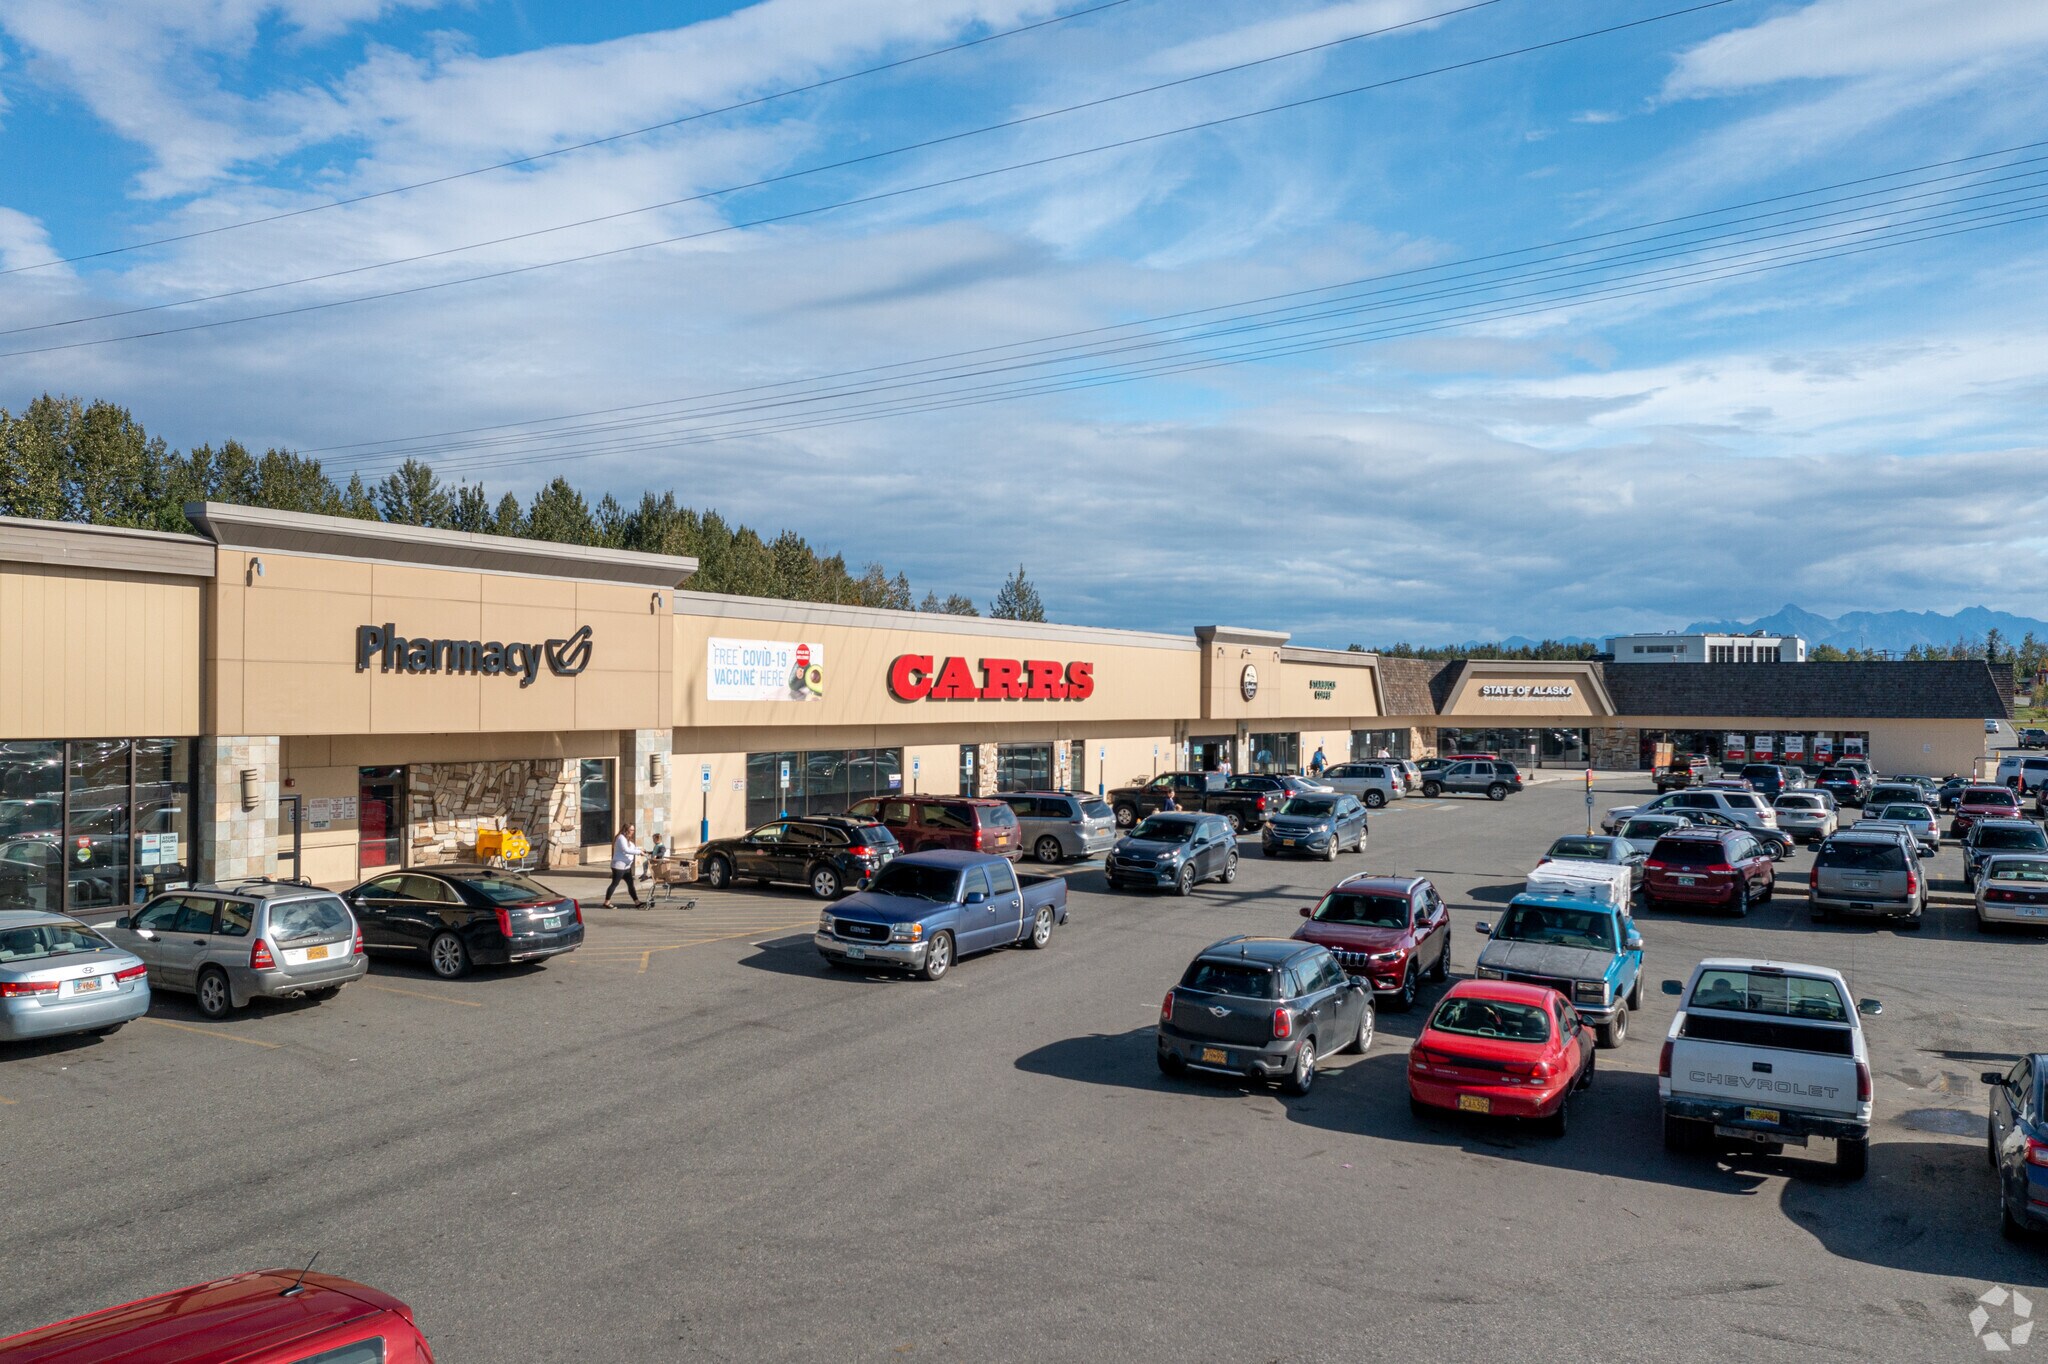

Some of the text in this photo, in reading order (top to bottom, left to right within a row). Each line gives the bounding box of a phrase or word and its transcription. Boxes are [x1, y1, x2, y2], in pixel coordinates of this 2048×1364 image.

[357, 623, 543, 687] Pharmacy
[714, 648, 739, 665] FREE
[743, 650, 787, 667] COVID-19
[714, 668, 784, 686] VACCINE HERE
[889, 654, 1094, 702] CARRS
[1482, 685, 1573, 695] STATE OF ALASKA
[1586, 796, 1593, 804] C
[850, 925, 871, 934] GMC
[302, 936, 345, 944] SUBARU
[1689, 1070, 1839, 1099] CHEVROLET
